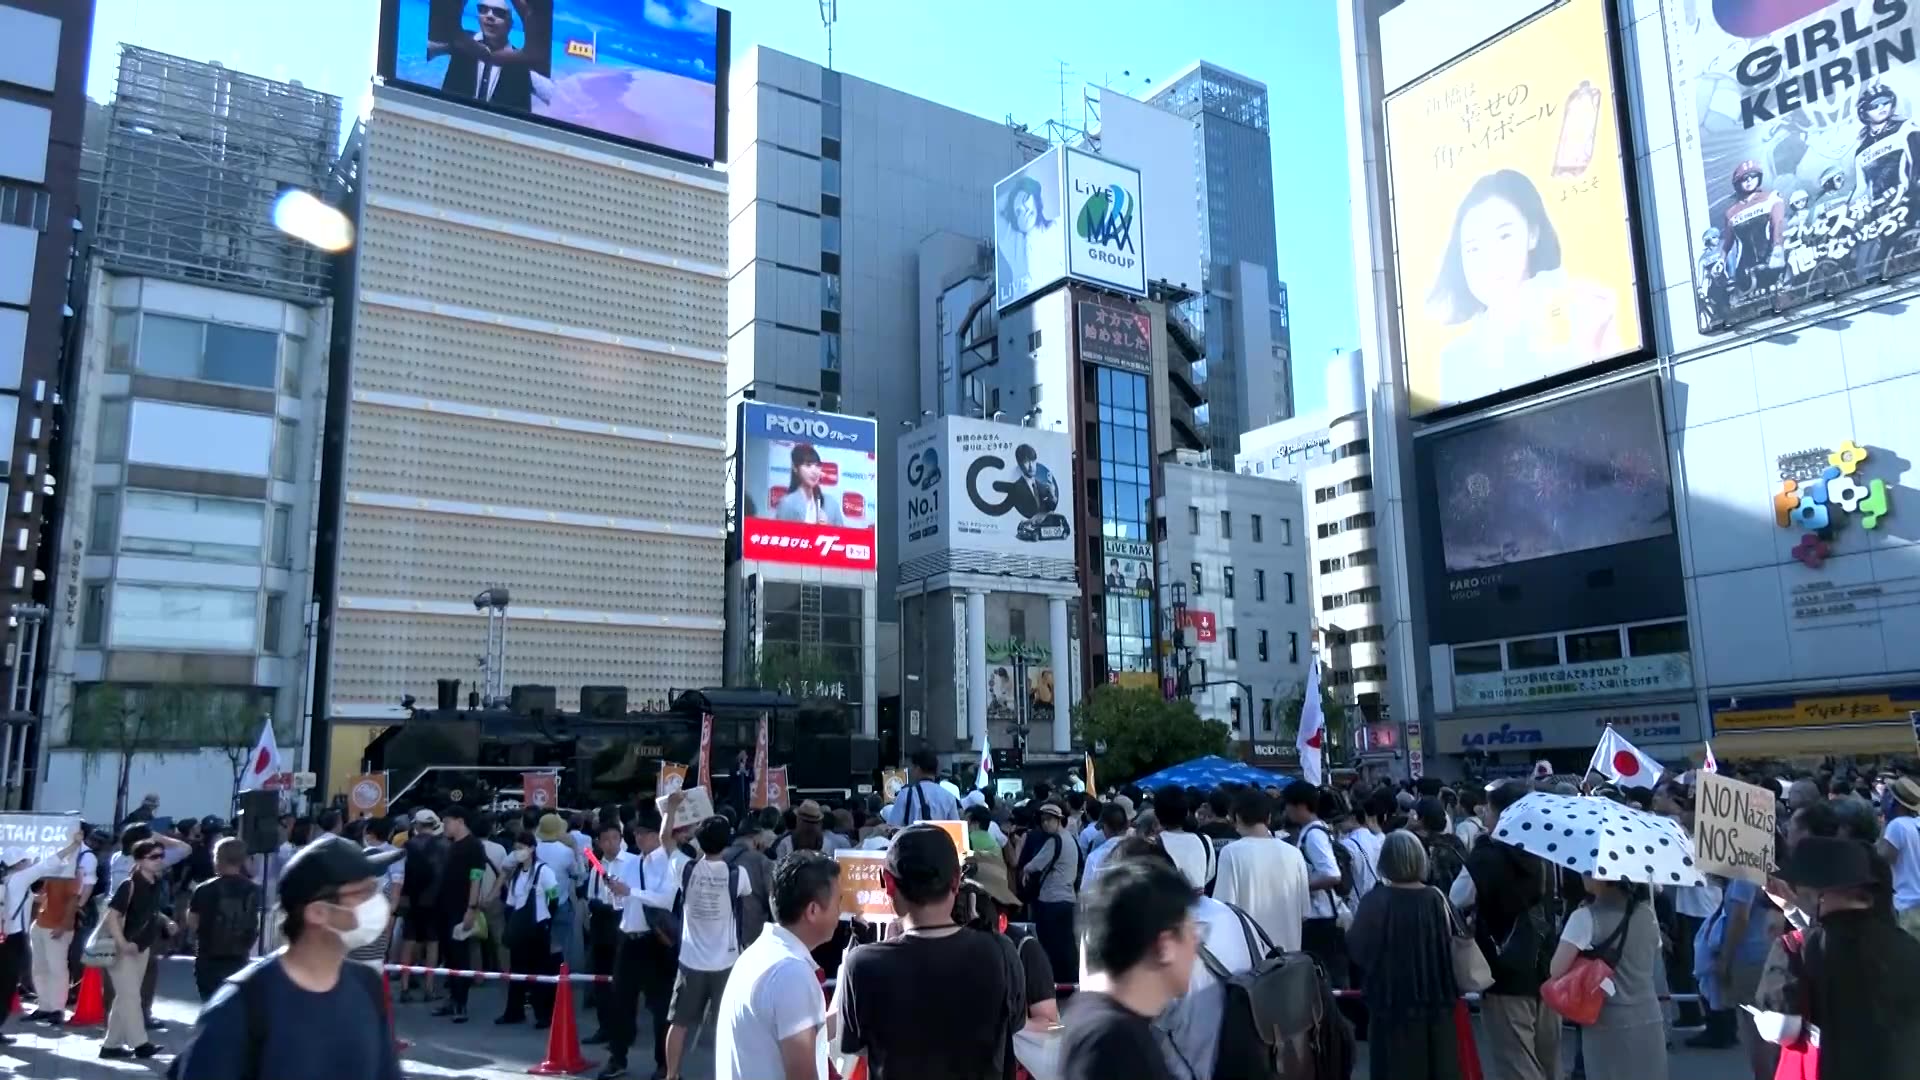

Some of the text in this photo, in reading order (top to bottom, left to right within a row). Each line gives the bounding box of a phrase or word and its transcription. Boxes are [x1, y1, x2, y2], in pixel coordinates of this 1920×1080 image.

[1736, 0, 1908, 86] GIRLS
[1740, 27, 1917, 130] KEIRIN
[1086, 207, 1136, 255] MAX
[1088, 248, 1135, 269] GROUP
[1095, 308, 1134, 329] オカマ
[1084, 323, 1147, 351] 始めました
[908, 490, 939, 521] No.1
[1129, 544, 1152, 556] MAX
[1449, 577, 1480, 591] FARO
[1701, 781, 1774, 834] NO Nazis
[1699, 821, 1727, 862] NO
